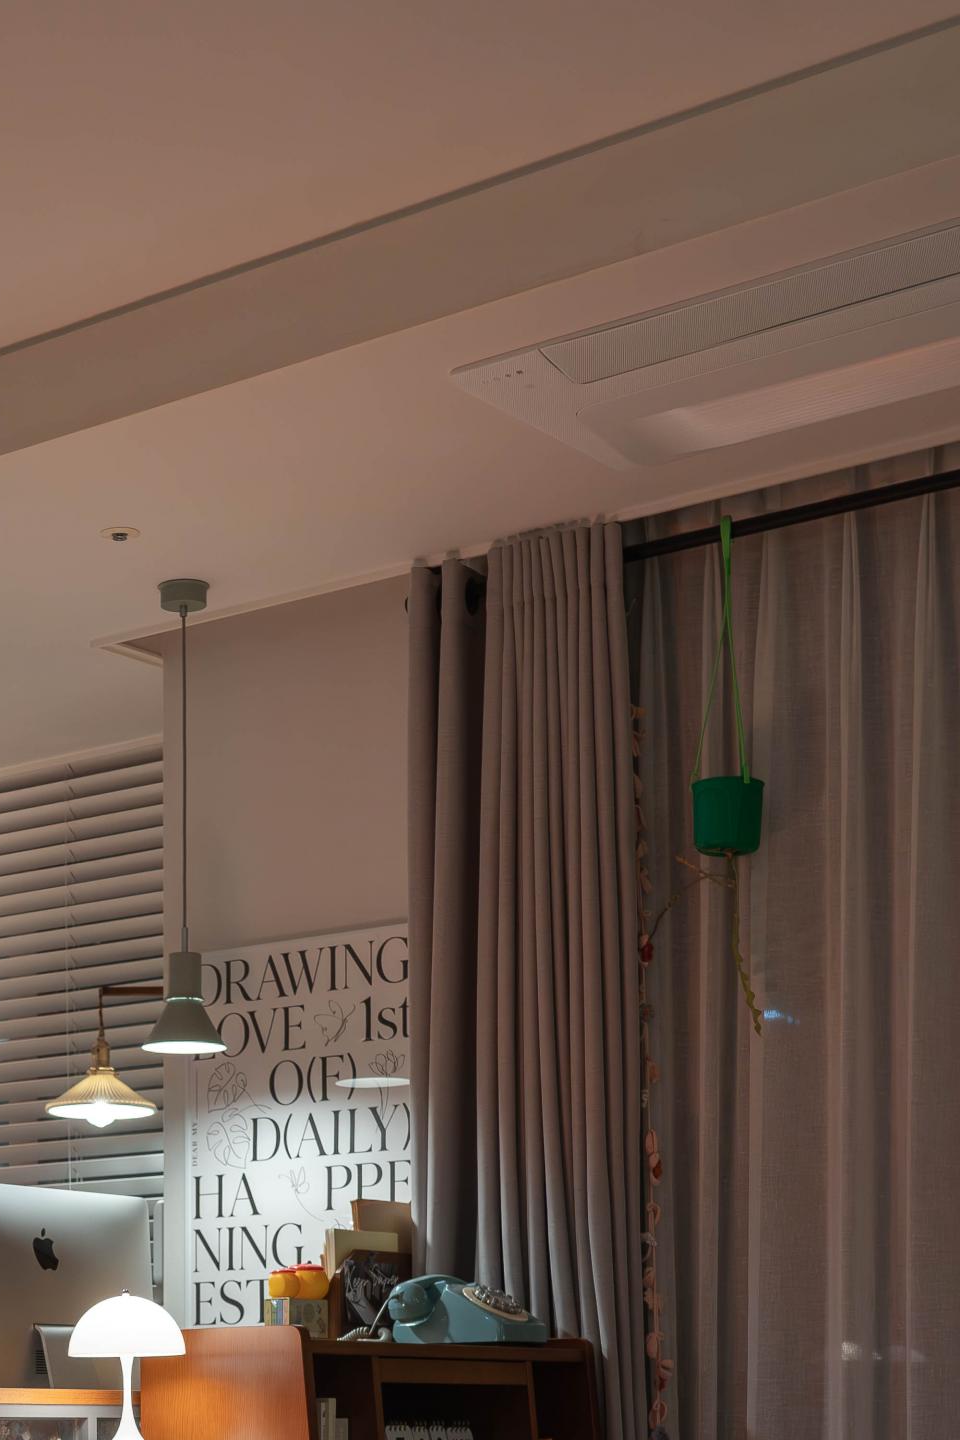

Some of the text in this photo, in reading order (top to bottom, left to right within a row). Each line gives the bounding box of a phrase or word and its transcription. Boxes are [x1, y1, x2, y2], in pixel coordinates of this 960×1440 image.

[201, 936, 409, 1007] DRAWING
[194, 996, 409, 1061] OVE 1st
[269, 1052, 357, 1106] O(F)
[191, 1122, 199, 1167] DEAR MY
[250, 1102, 410, 1162] D(AILY)
[194, 1172, 262, 1220] HA
